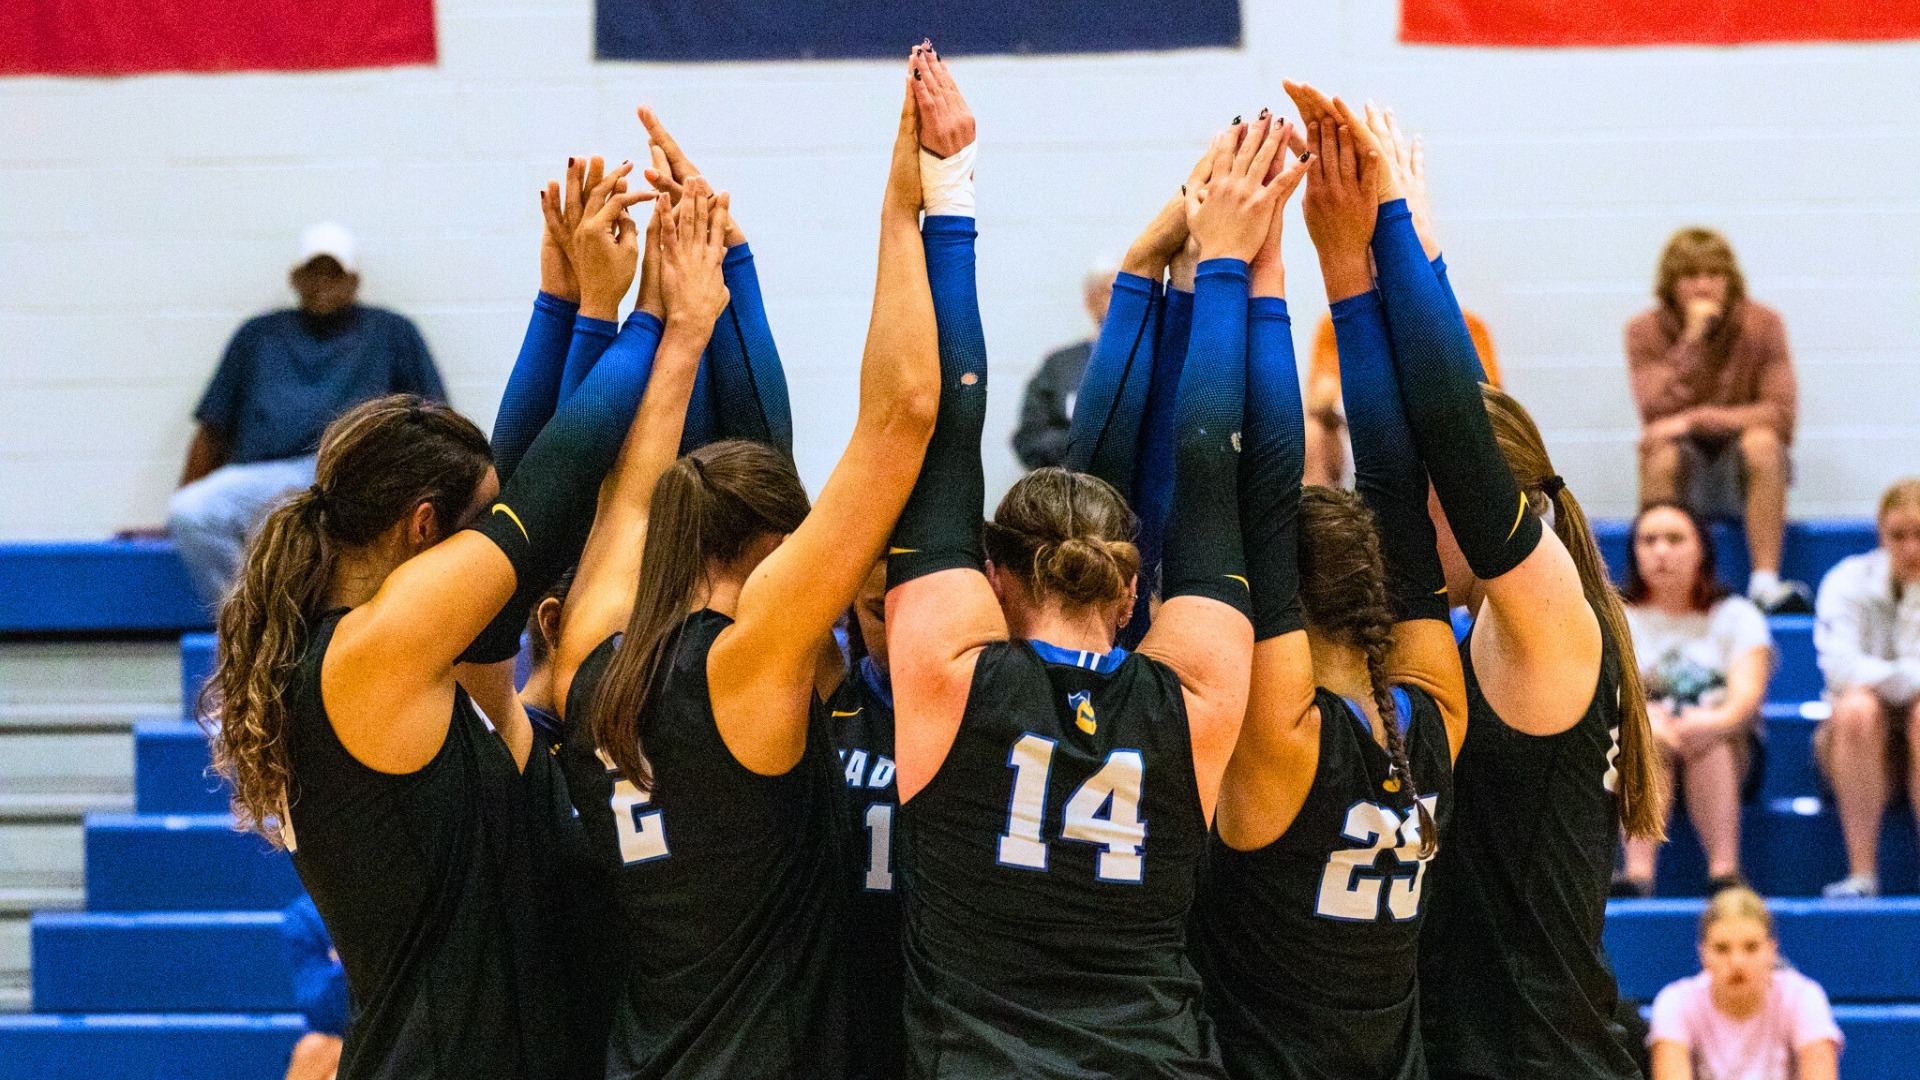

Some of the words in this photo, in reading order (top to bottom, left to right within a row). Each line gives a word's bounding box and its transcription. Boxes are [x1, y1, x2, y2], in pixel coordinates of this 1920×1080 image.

[839, 749, 896, 789] AD
[996, 731, 1148, 884] 14
[1313, 792, 1439, 922] 25
